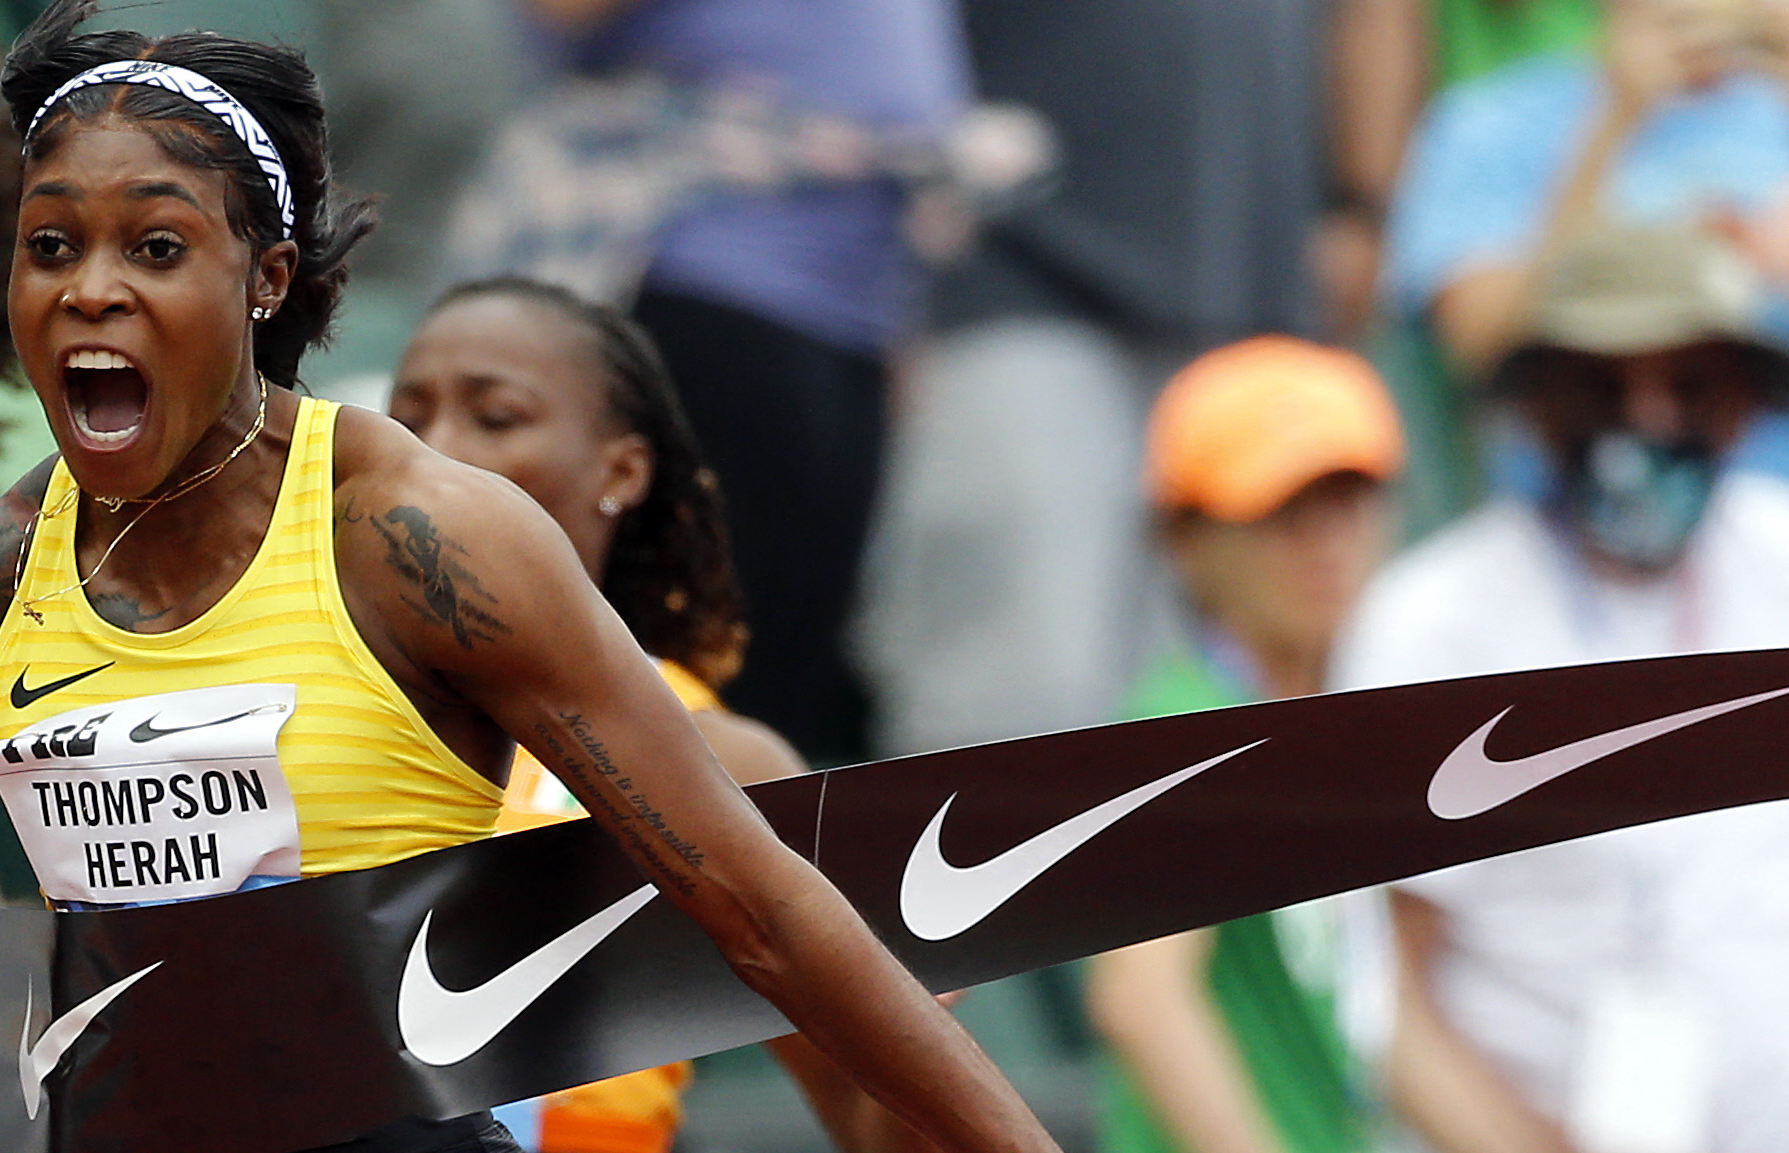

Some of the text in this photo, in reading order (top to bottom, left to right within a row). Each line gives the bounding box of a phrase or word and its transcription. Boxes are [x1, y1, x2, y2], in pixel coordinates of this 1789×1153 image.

[560, 713, 618, 775] Nothing
[32, 769, 268, 827] THOMPSON
[83, 832, 221, 888] HERAH
